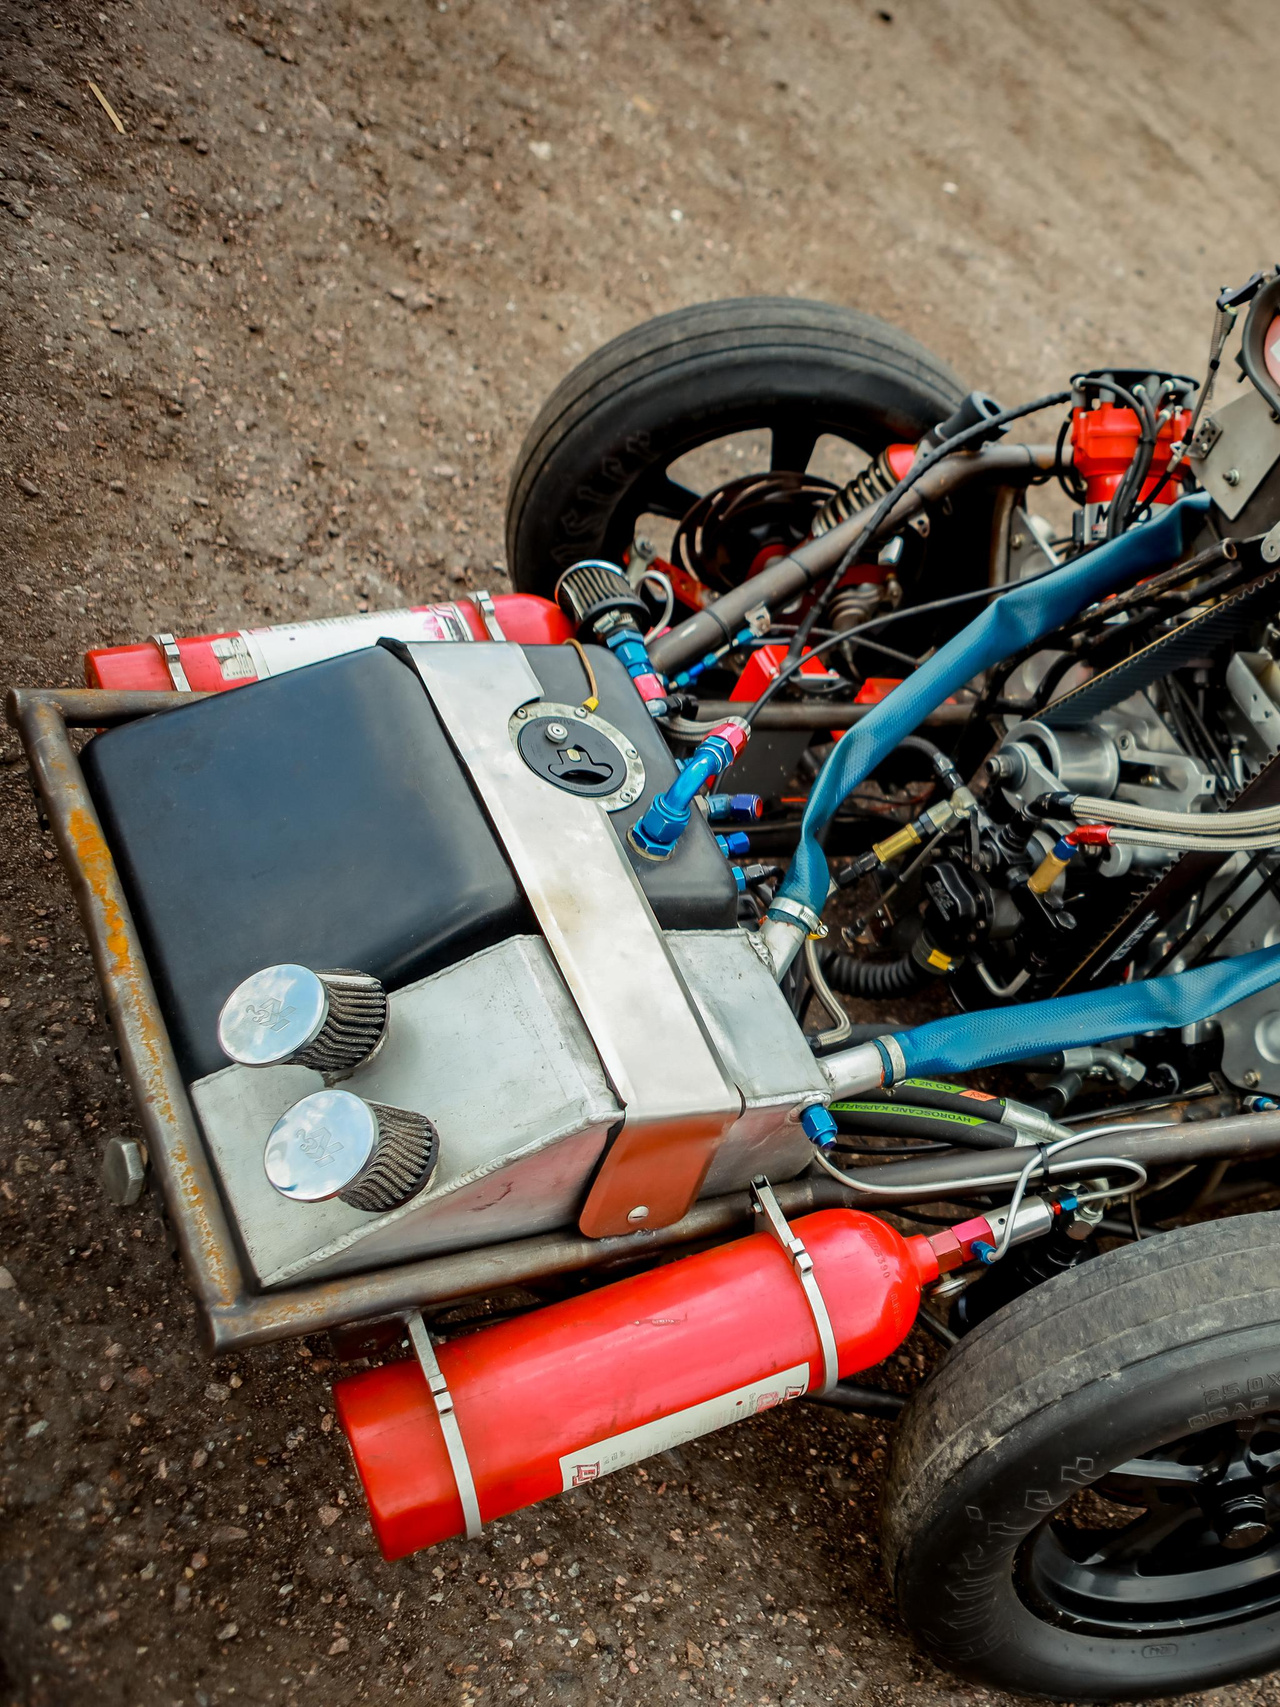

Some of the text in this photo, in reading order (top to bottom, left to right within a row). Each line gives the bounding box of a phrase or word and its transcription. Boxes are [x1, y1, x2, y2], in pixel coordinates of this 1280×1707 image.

[834, 1103, 971, 1123] HYDROSCAND KAPPAFLEX
[1187, 1395, 1270, 1429] DRAG
